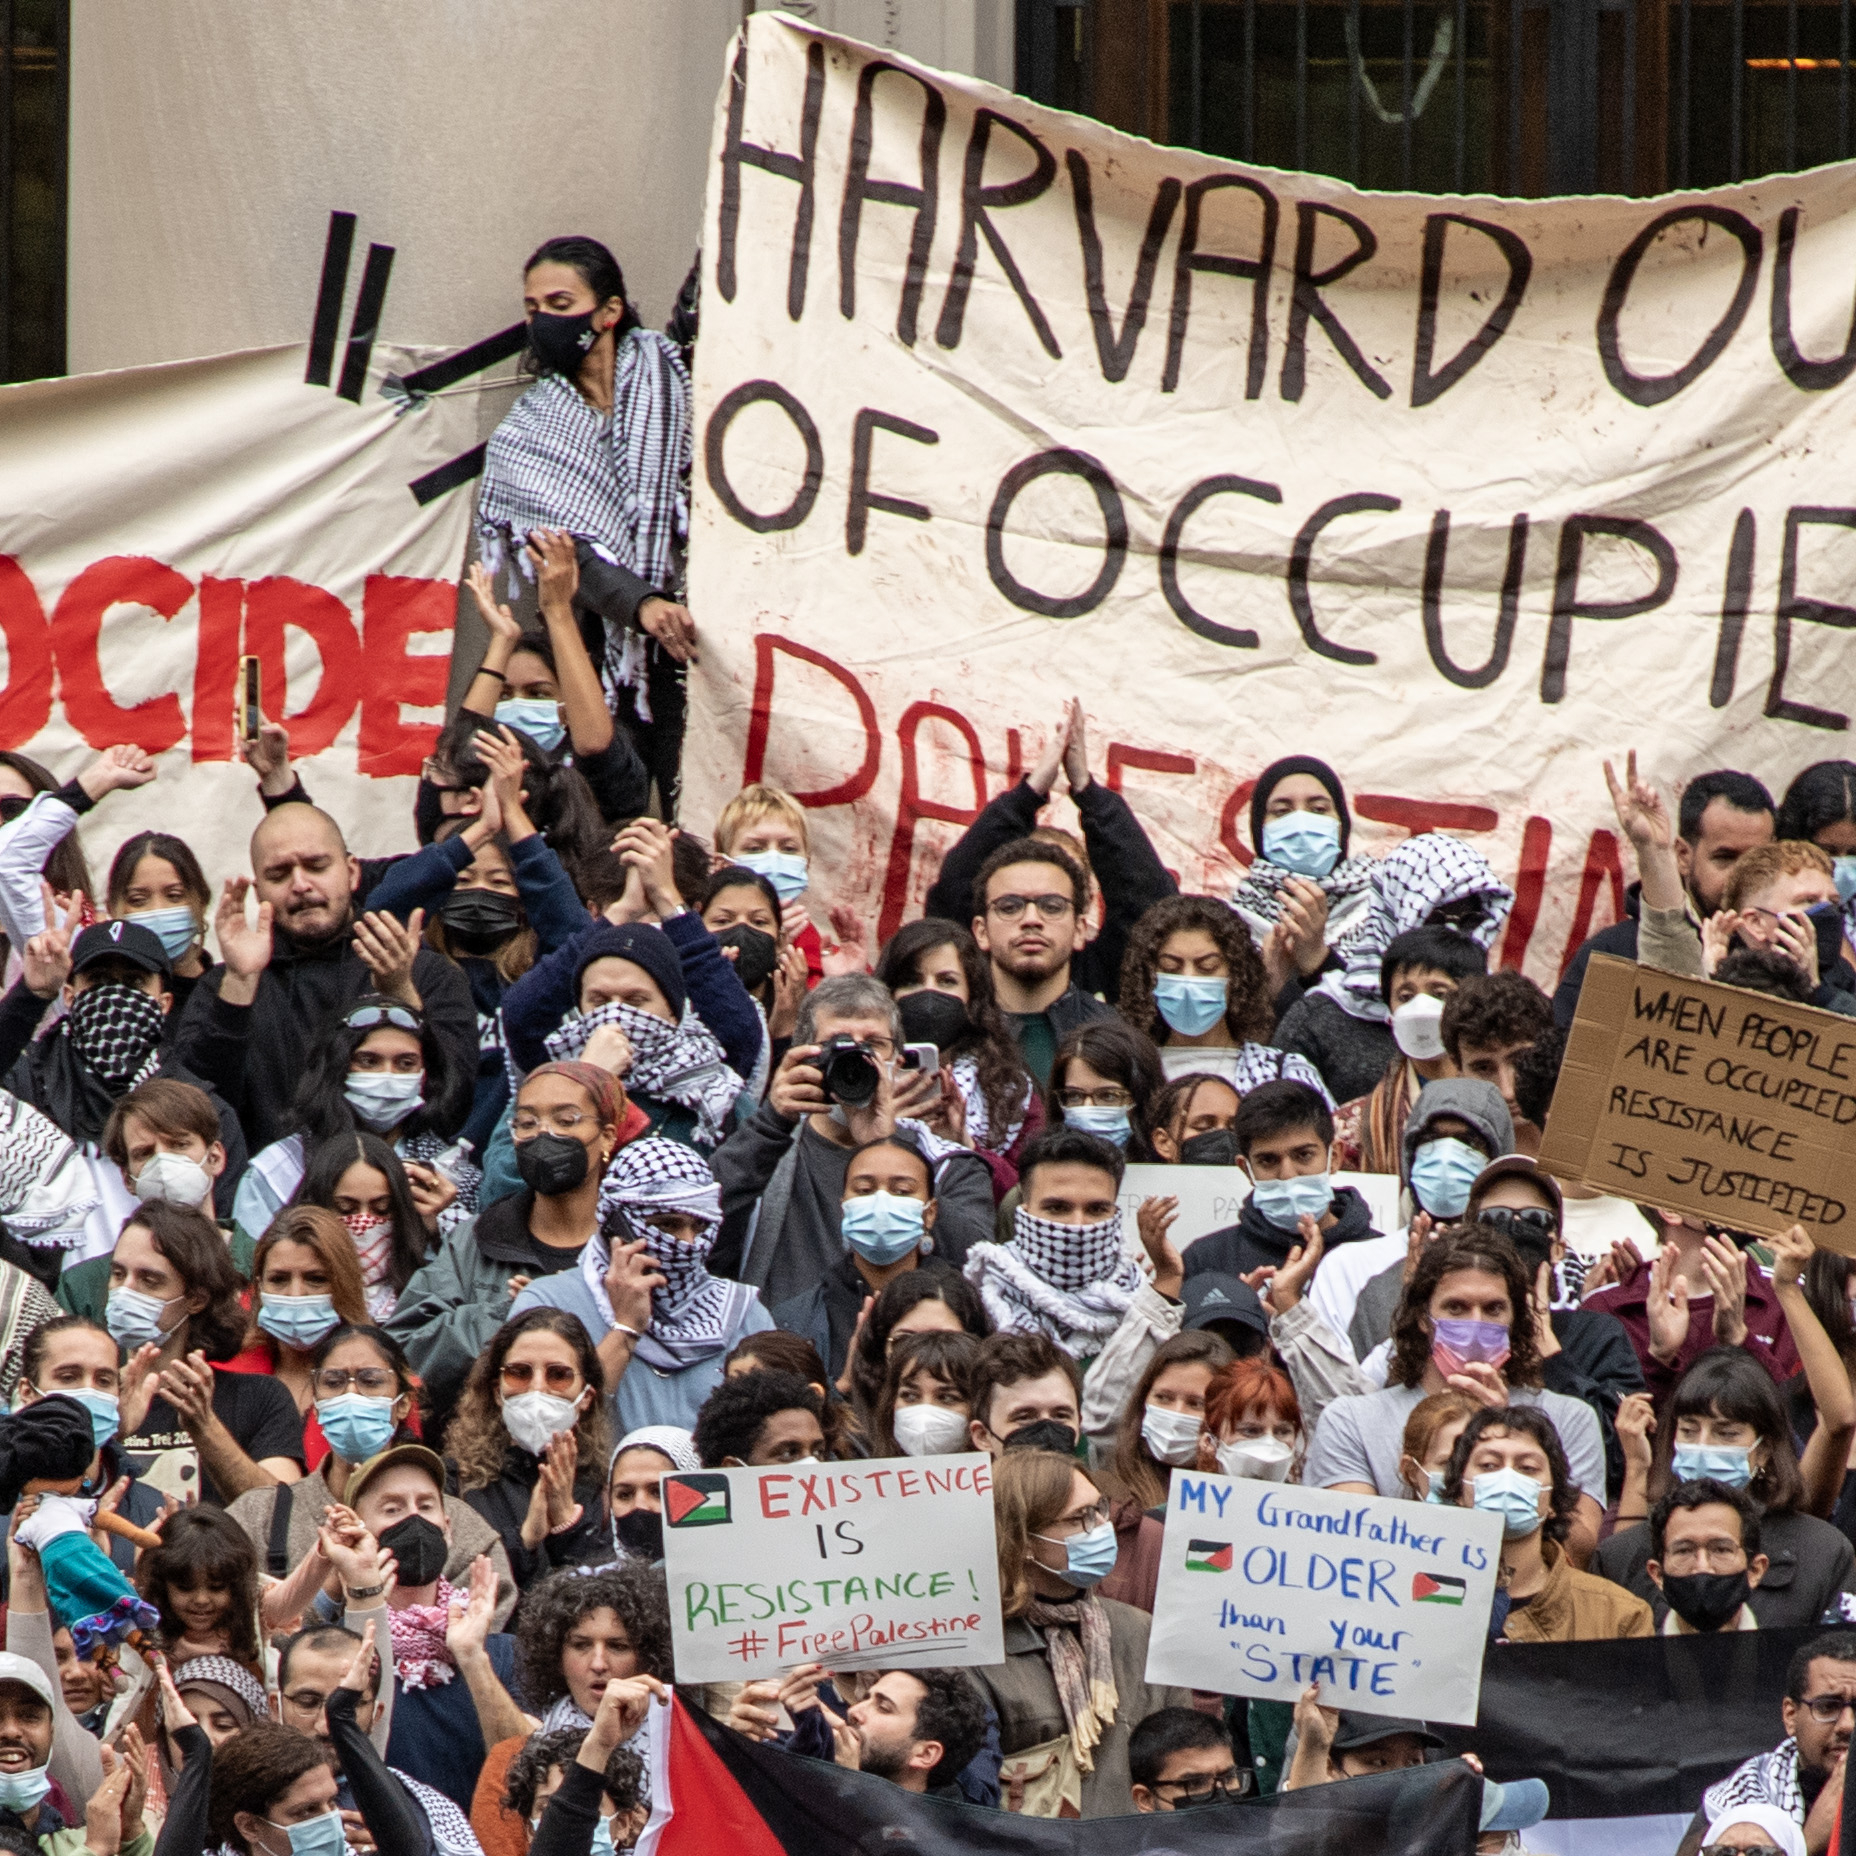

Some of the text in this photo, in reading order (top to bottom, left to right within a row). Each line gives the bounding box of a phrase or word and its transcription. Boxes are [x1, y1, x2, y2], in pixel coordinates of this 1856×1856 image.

[716, 40, 1532, 407] HARVARD
[704, 379, 941, 556] OF
[1625, 1036, 1696, 1075] ARE
[1634, 986, 1856, 1080] WHEN PEOPLE
[1608, 1085, 1799, 1161] RESISTANCE
[1608, 1143, 1846, 1224] IS JUSTIFIED
[758, 1464, 993, 1519] EXISTENCE
[816, 1521, 864, 1559] IS
[1179, 1478, 1487, 1571] MY Grandfather is
[685, 1569, 980, 1632] RESISTANCE!
[1243, 1546, 1401, 1608] OLDER
[727, 1613, 982, 1661] #FreePalestine
[1212, 1599, 1286, 1635] than
